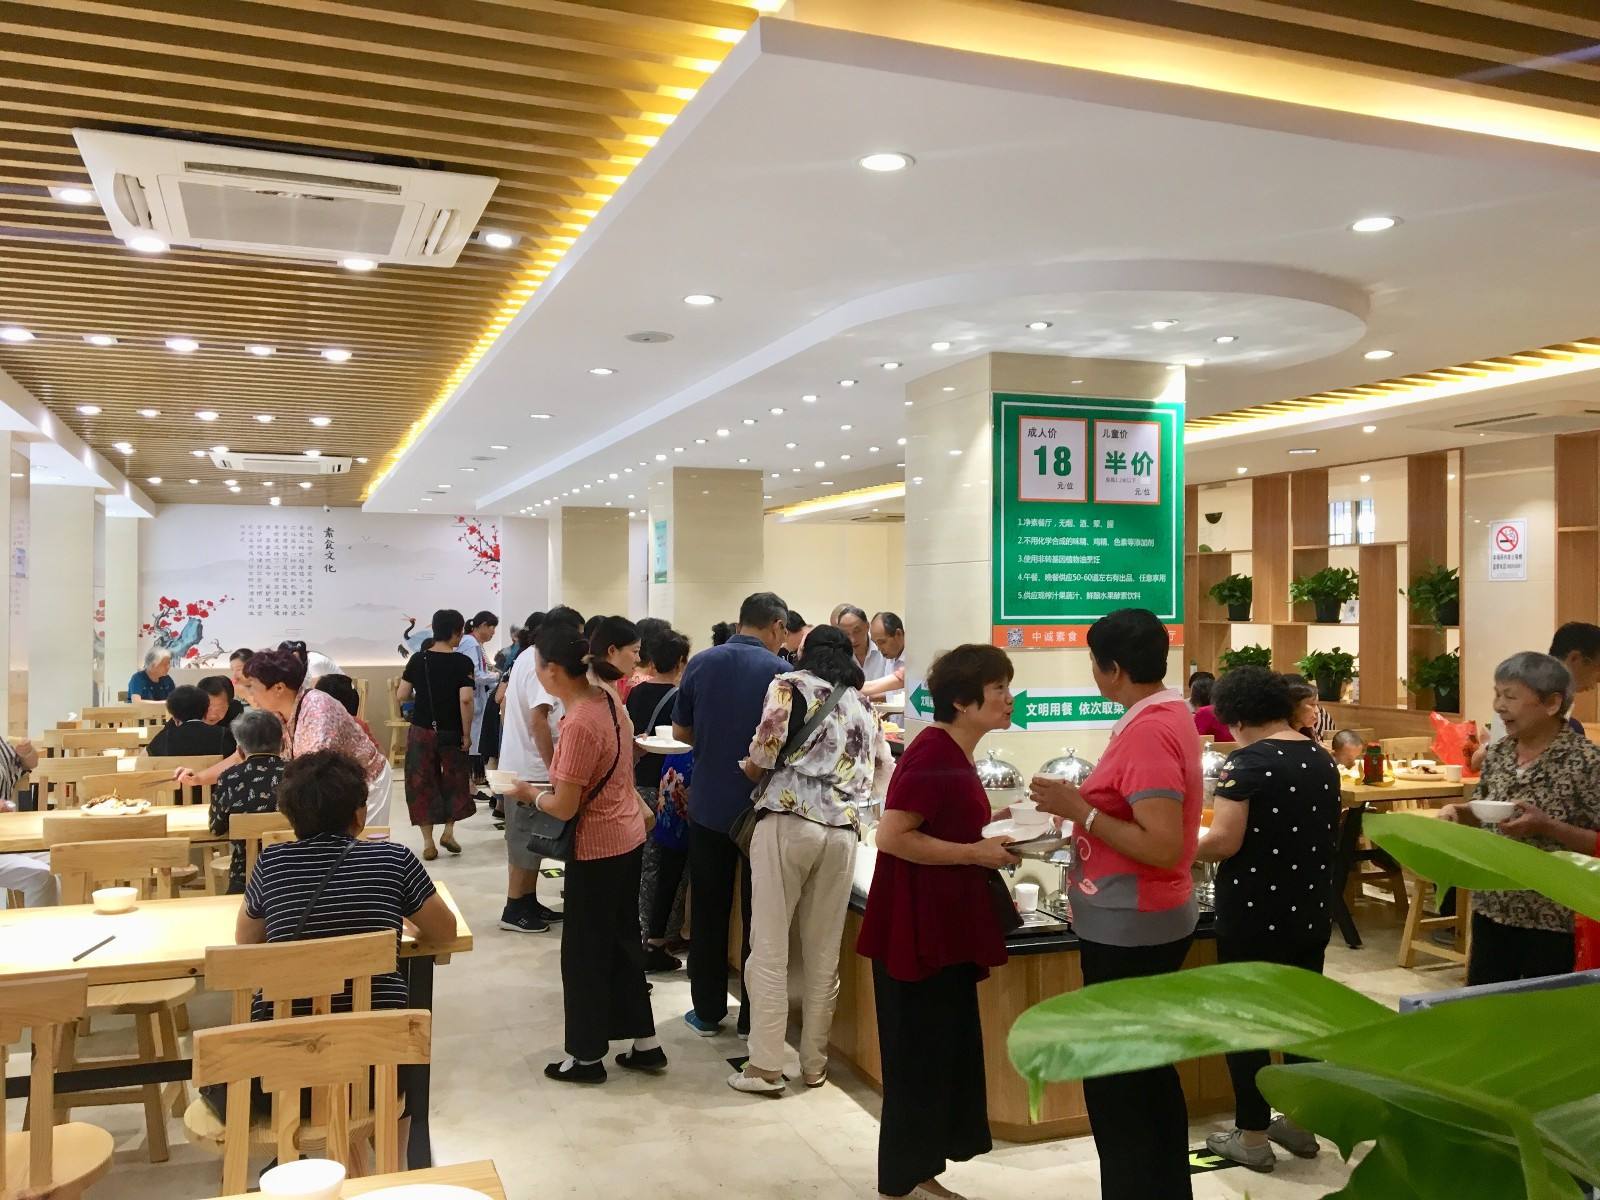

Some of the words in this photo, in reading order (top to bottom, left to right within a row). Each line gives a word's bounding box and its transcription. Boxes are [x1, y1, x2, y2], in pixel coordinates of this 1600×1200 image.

[1028, 428, 1056, 438] 成人价
[1102, 429, 1128, 439] 儿童价
[1034, 445, 1071, 476] 18
[1105, 450, 1154, 477] 半价
[1057, 482, 1074, 490] 元/位
[323, 527, 336, 573] 素食文化
[1032, 631, 1078, 642] 中诚素食
[1026, 702, 1073, 717] 文明用餐
